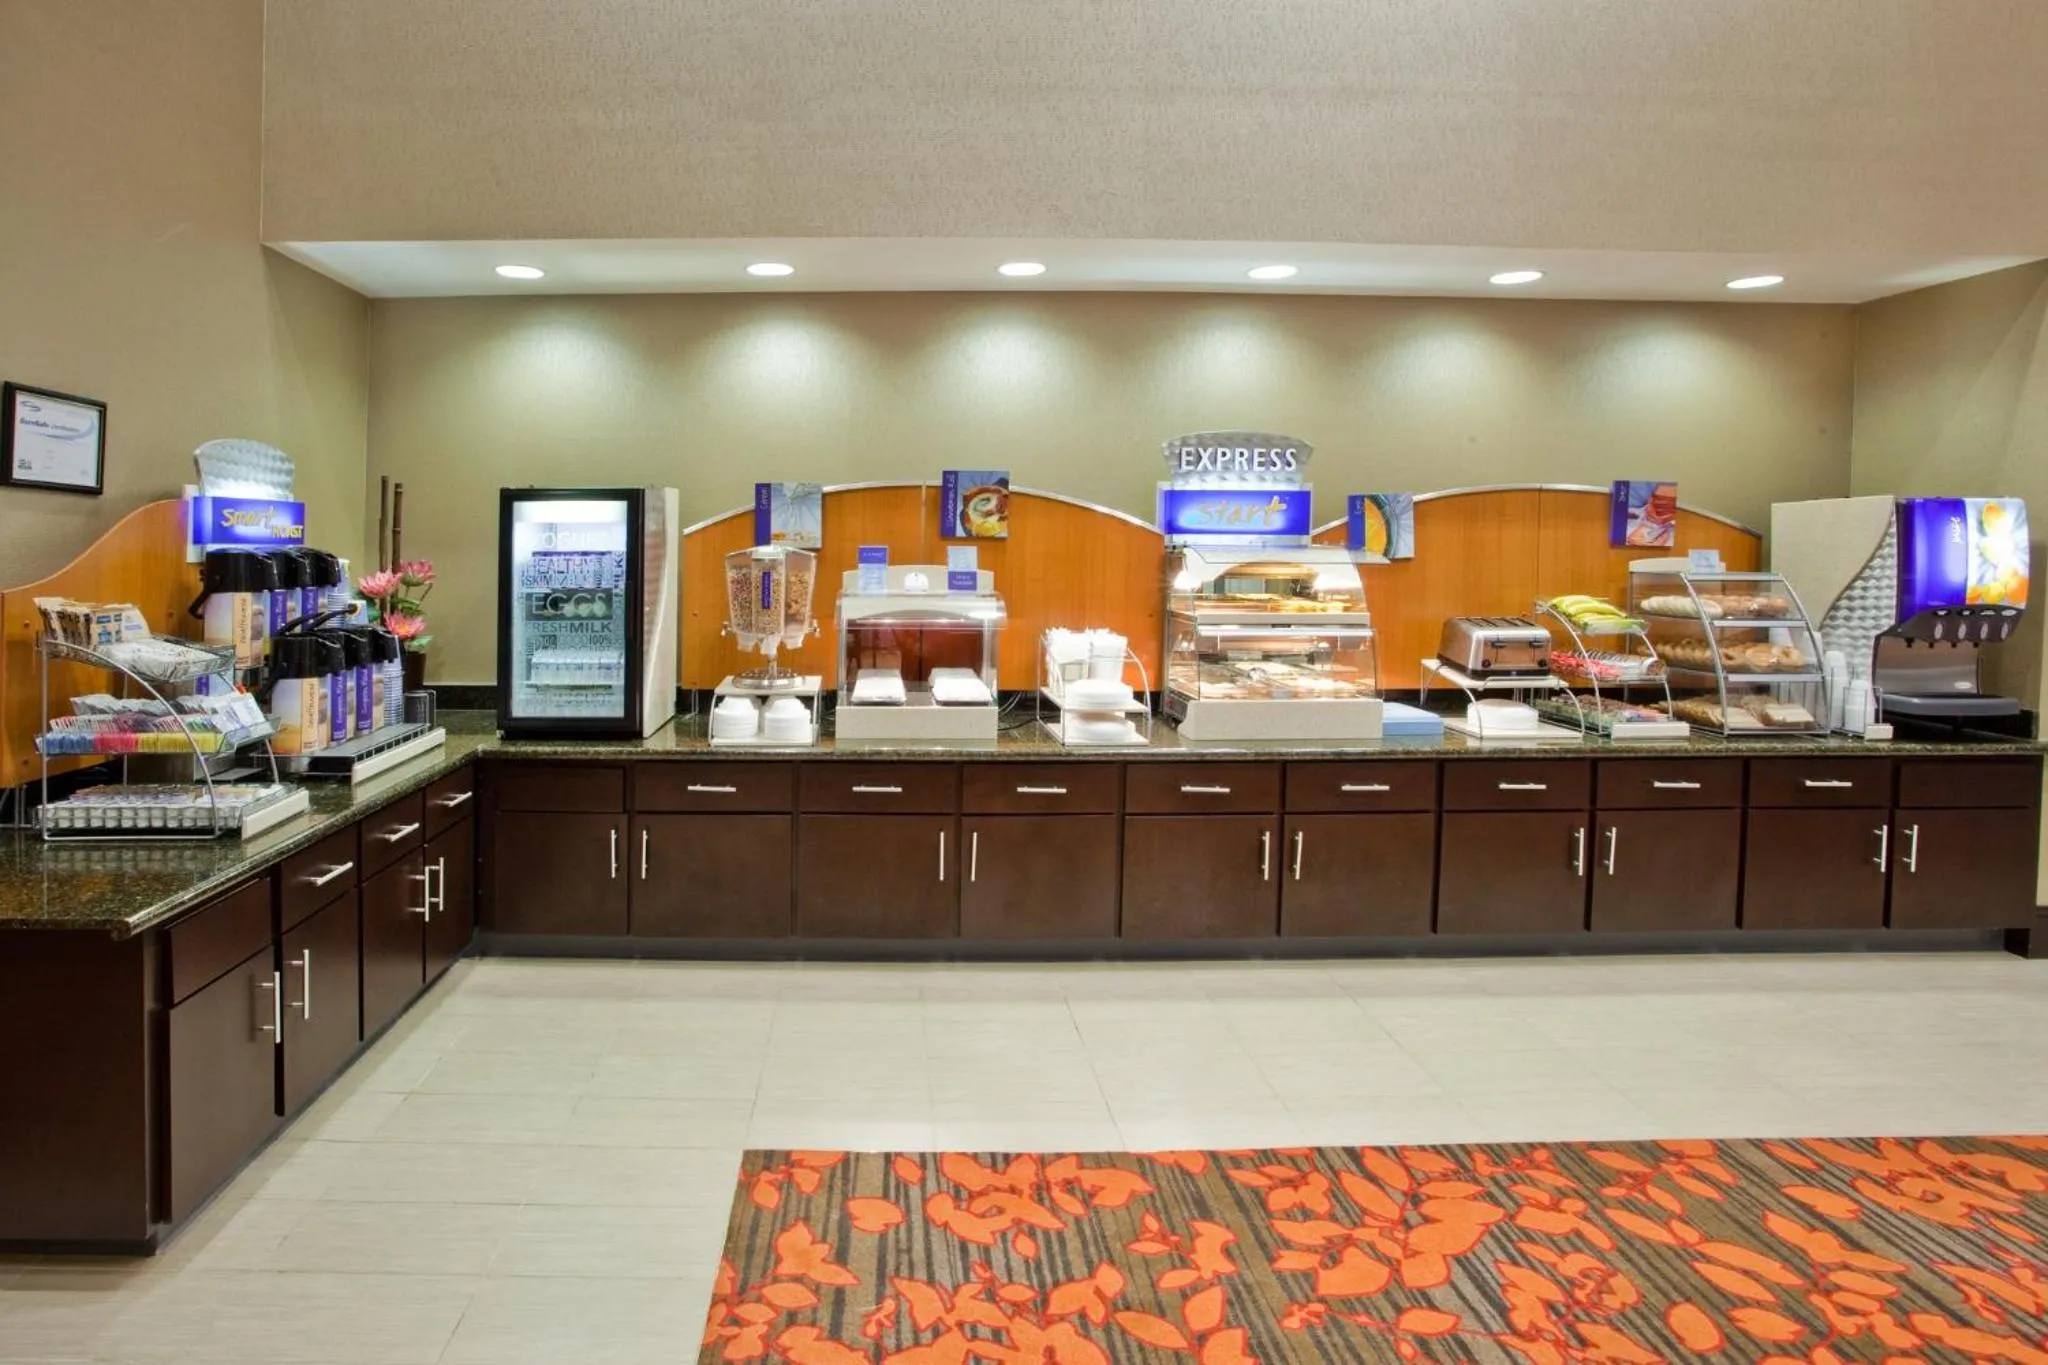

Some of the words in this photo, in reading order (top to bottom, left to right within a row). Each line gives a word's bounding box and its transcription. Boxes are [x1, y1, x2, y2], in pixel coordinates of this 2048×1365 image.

[1180, 447, 1297, 472] EXPRESS
[220, 506, 274, 529] Smart
[532, 592, 606, 614] EGGS
